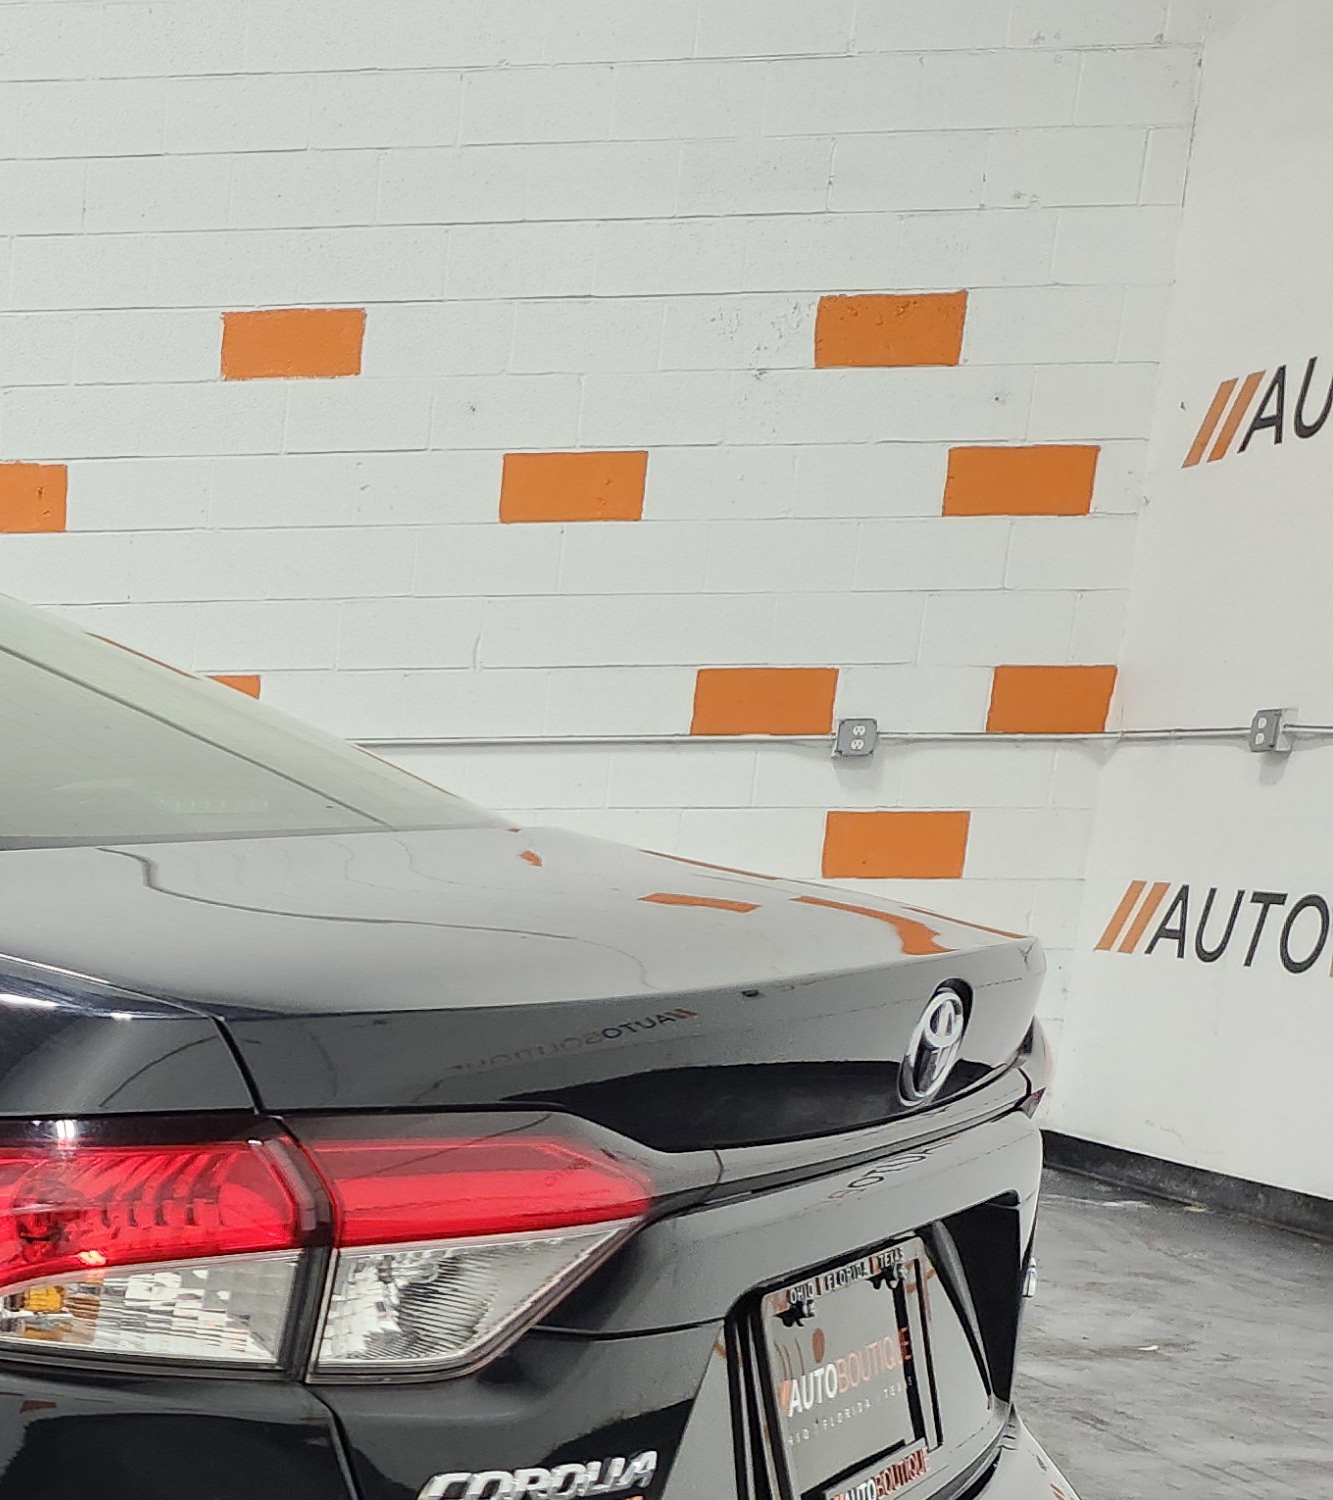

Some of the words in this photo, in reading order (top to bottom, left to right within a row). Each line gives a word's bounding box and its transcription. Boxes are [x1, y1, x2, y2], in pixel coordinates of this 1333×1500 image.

[1143, 884, 1333, 977] AUTO
[788, 1282, 814, 1304] OHIO
[824, 1261, 869, 1291] FLORIDA
[878, 1247, 905, 1268] TEXAS
